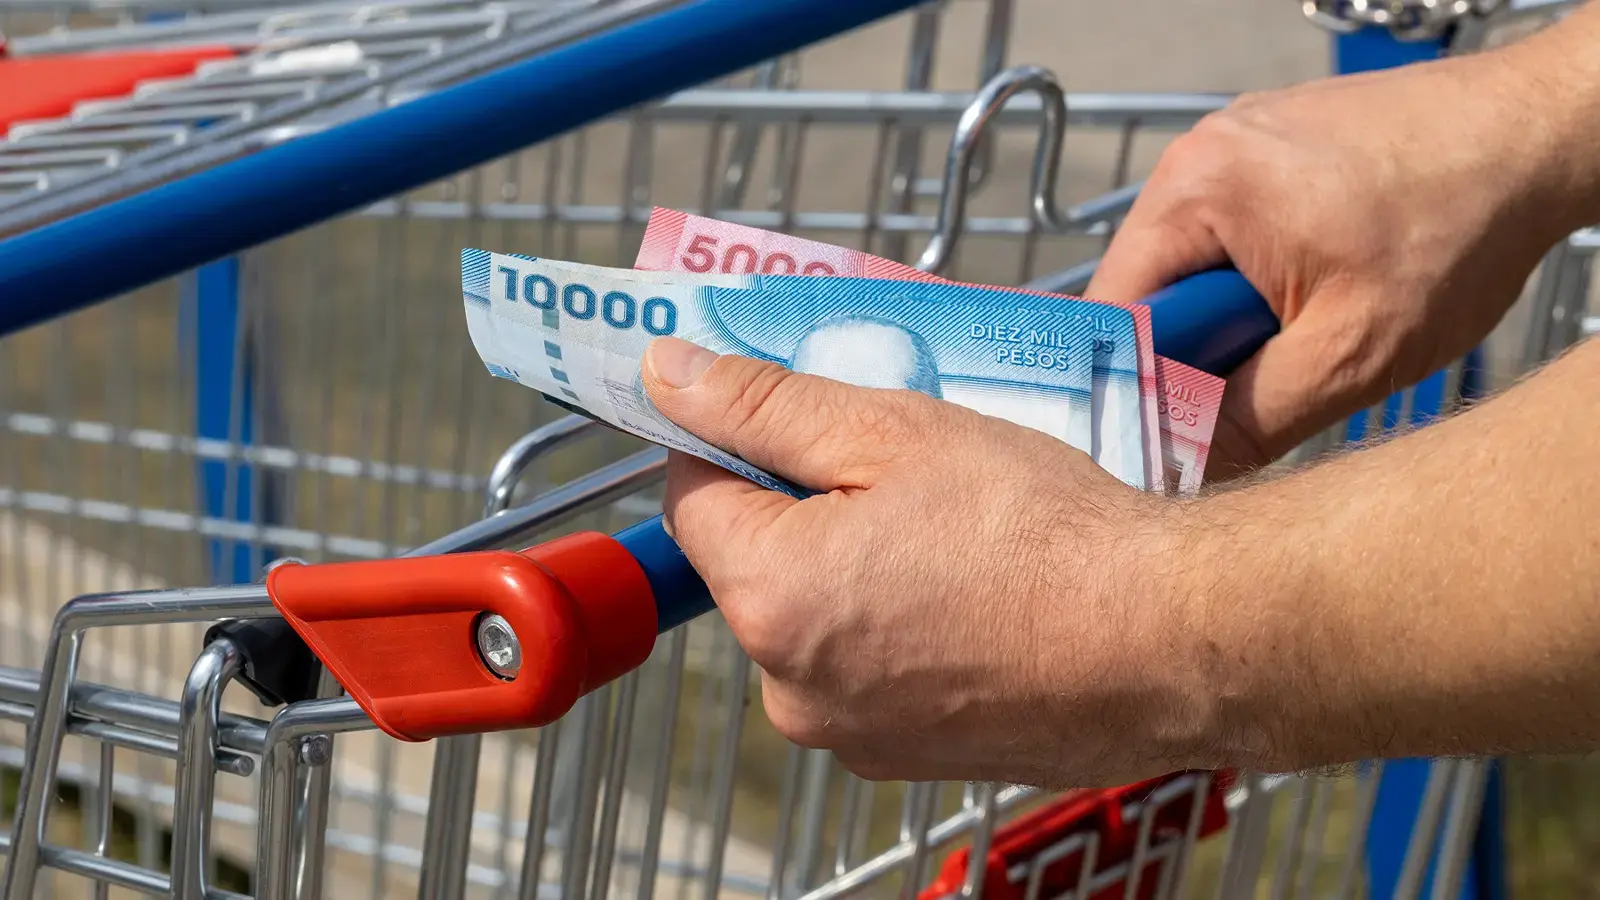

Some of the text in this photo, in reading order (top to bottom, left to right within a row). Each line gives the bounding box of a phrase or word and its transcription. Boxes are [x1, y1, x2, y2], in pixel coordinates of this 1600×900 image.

[497, 265, 678, 337] 10000
[970, 323, 1021, 343] DIEZ
[1030, 329, 1069, 349] MIL
[996, 347, 1069, 371] PESOS
[1165, 379, 1200, 407] MIL
[1158, 400, 1198, 426] SOS
